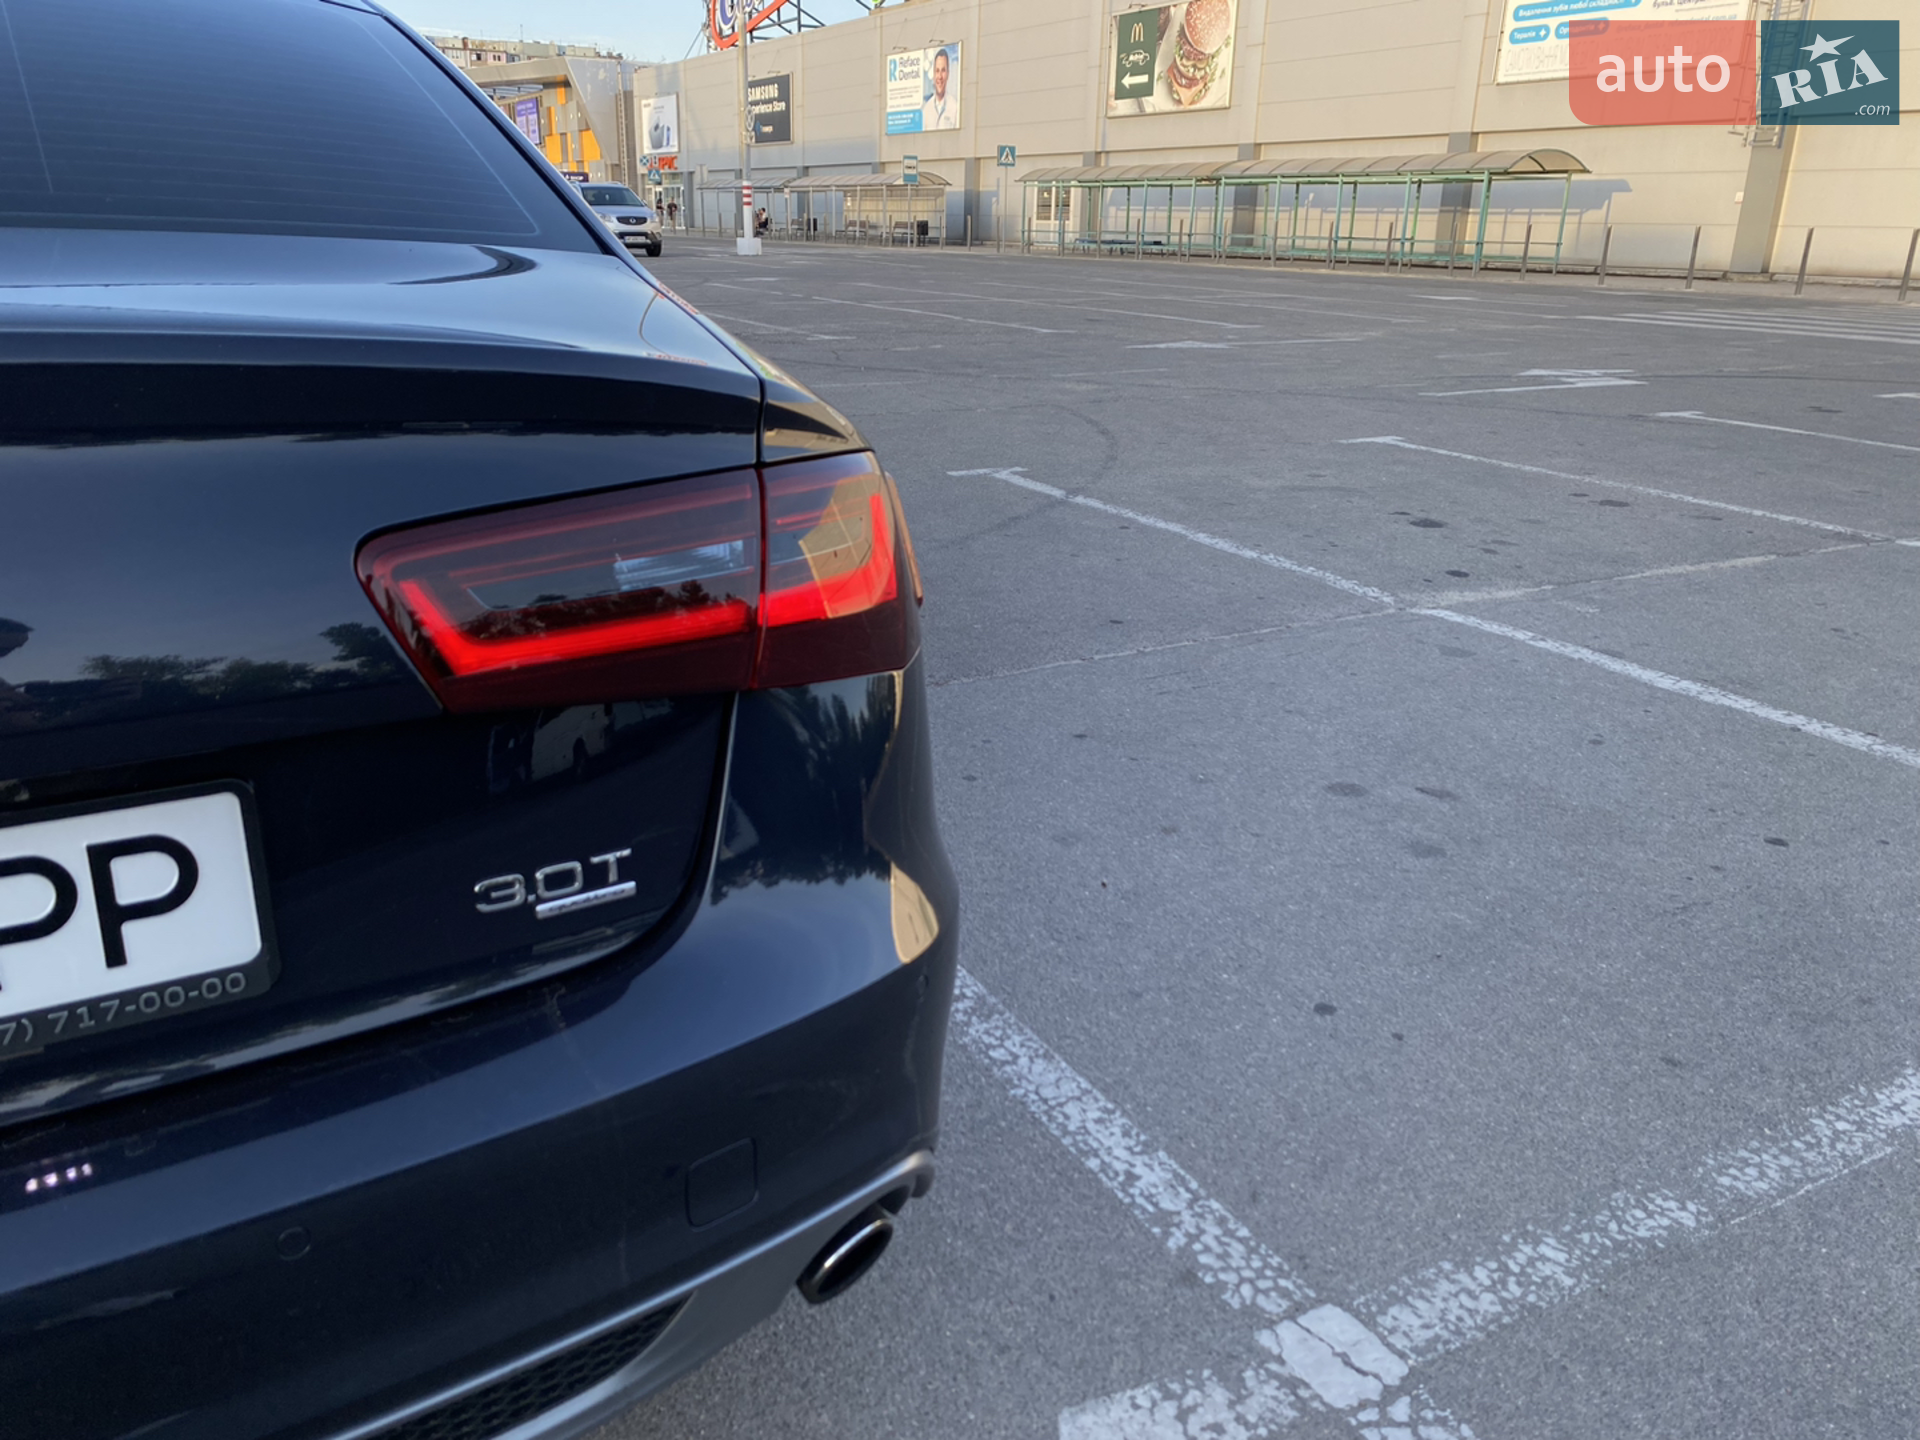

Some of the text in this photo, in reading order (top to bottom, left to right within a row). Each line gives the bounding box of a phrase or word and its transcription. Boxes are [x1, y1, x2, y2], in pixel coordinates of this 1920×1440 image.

[1518, 6, 1552, 17] Видалення
[898, 56, 921, 69] Reface
[898, 68, 921, 81] Dental
[748, 83, 779, 102] SAMSUNG
[773, 100, 786, 112] Store
[47, 972, 247, 1034] 717-00-00
